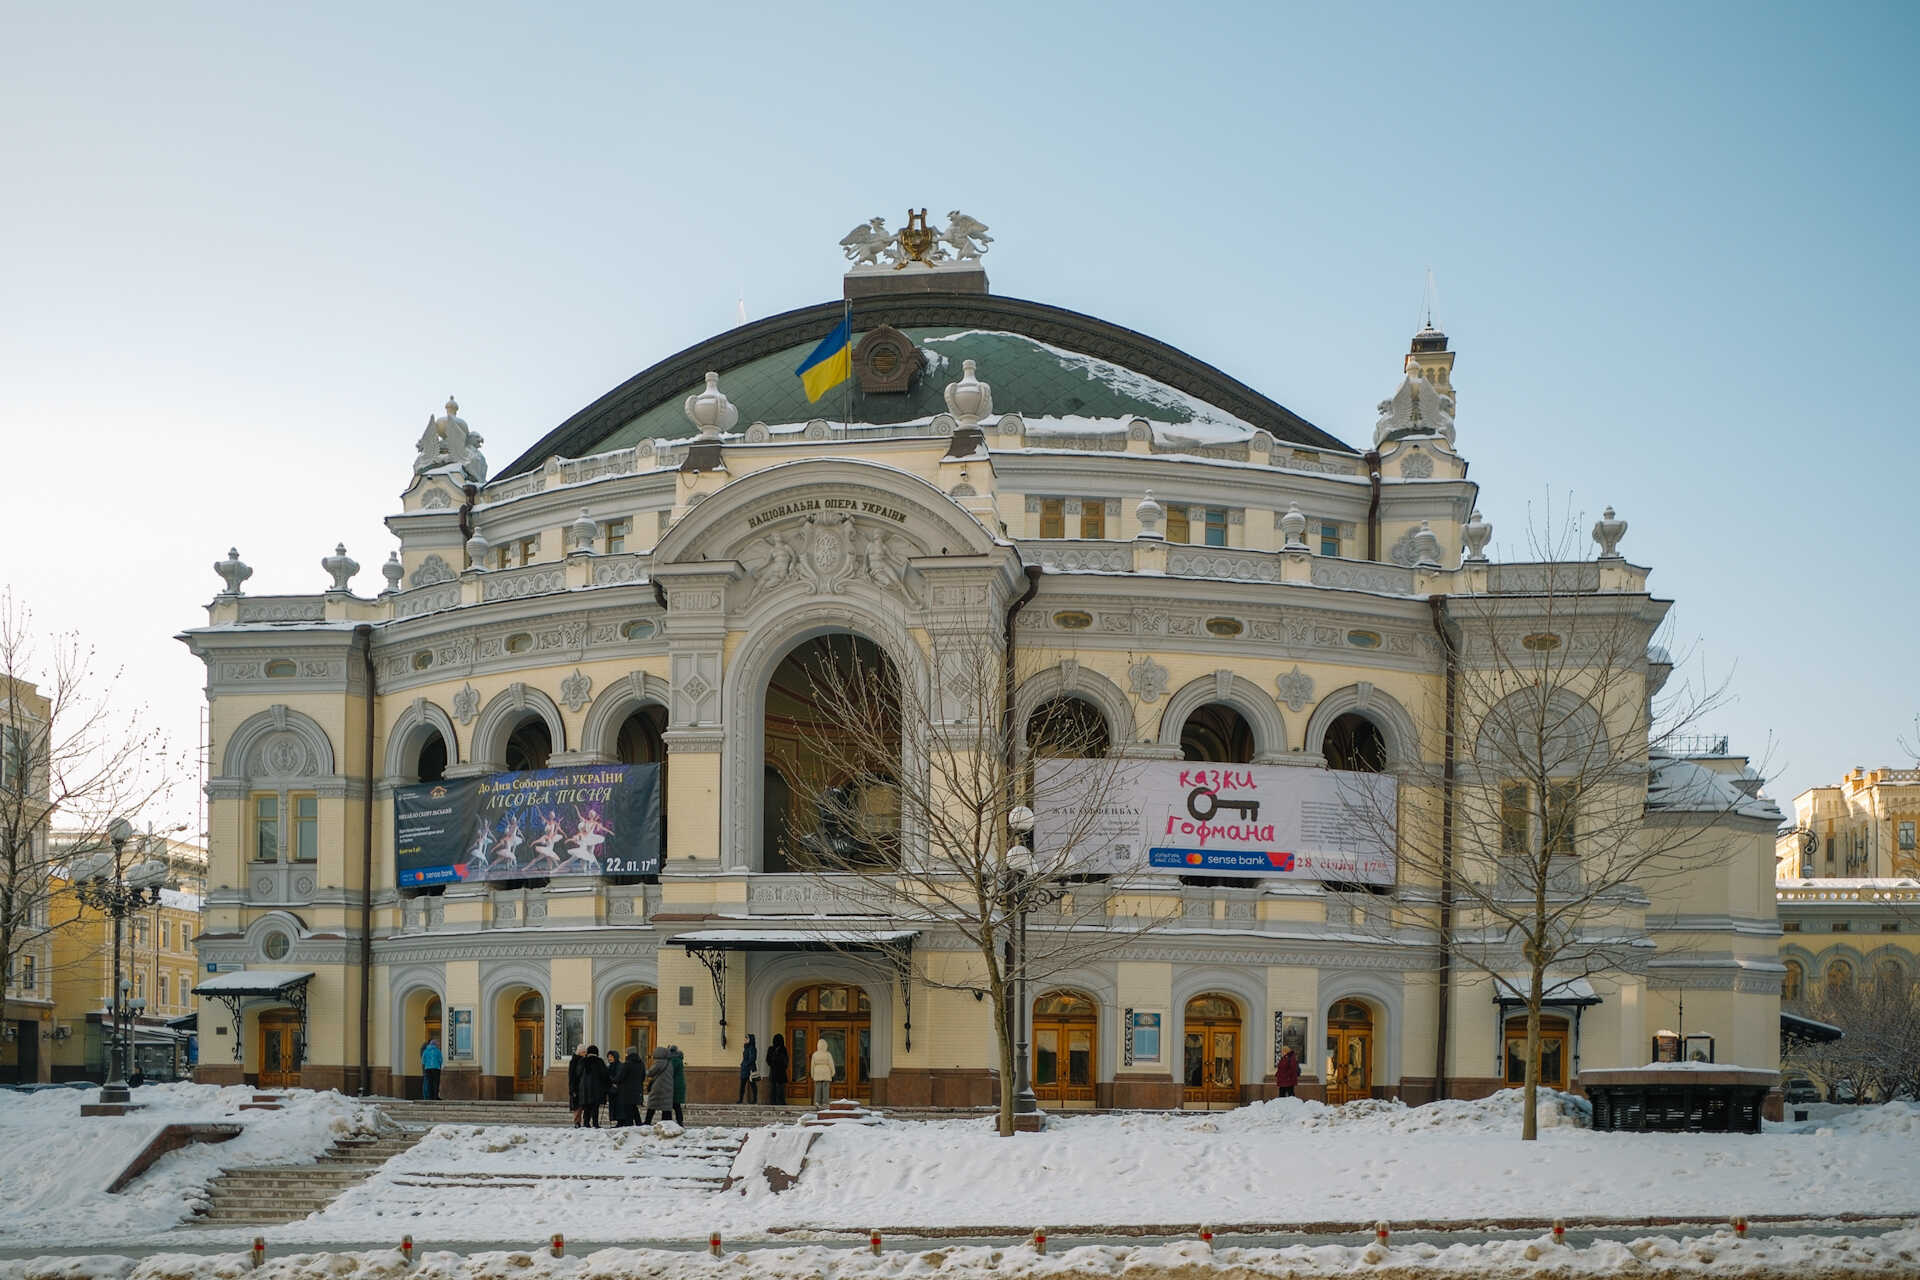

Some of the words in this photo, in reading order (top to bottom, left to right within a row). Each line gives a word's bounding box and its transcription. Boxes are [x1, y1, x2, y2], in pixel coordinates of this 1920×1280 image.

[748, 500, 821, 528] НАЦІОНАЛЬНА
[825, 499, 858, 511] ОПЕРА
[478, 783, 490, 795] До
[512, 775, 569, 790] Соборності
[572, 771, 624, 785] УКРАЇНИ
[1166, 815, 1275, 846] Гофмана
[1208, 855, 1237, 864] sense
[1239, 855, 1265, 865] bank
[1297, 857, 1312, 867] 28
